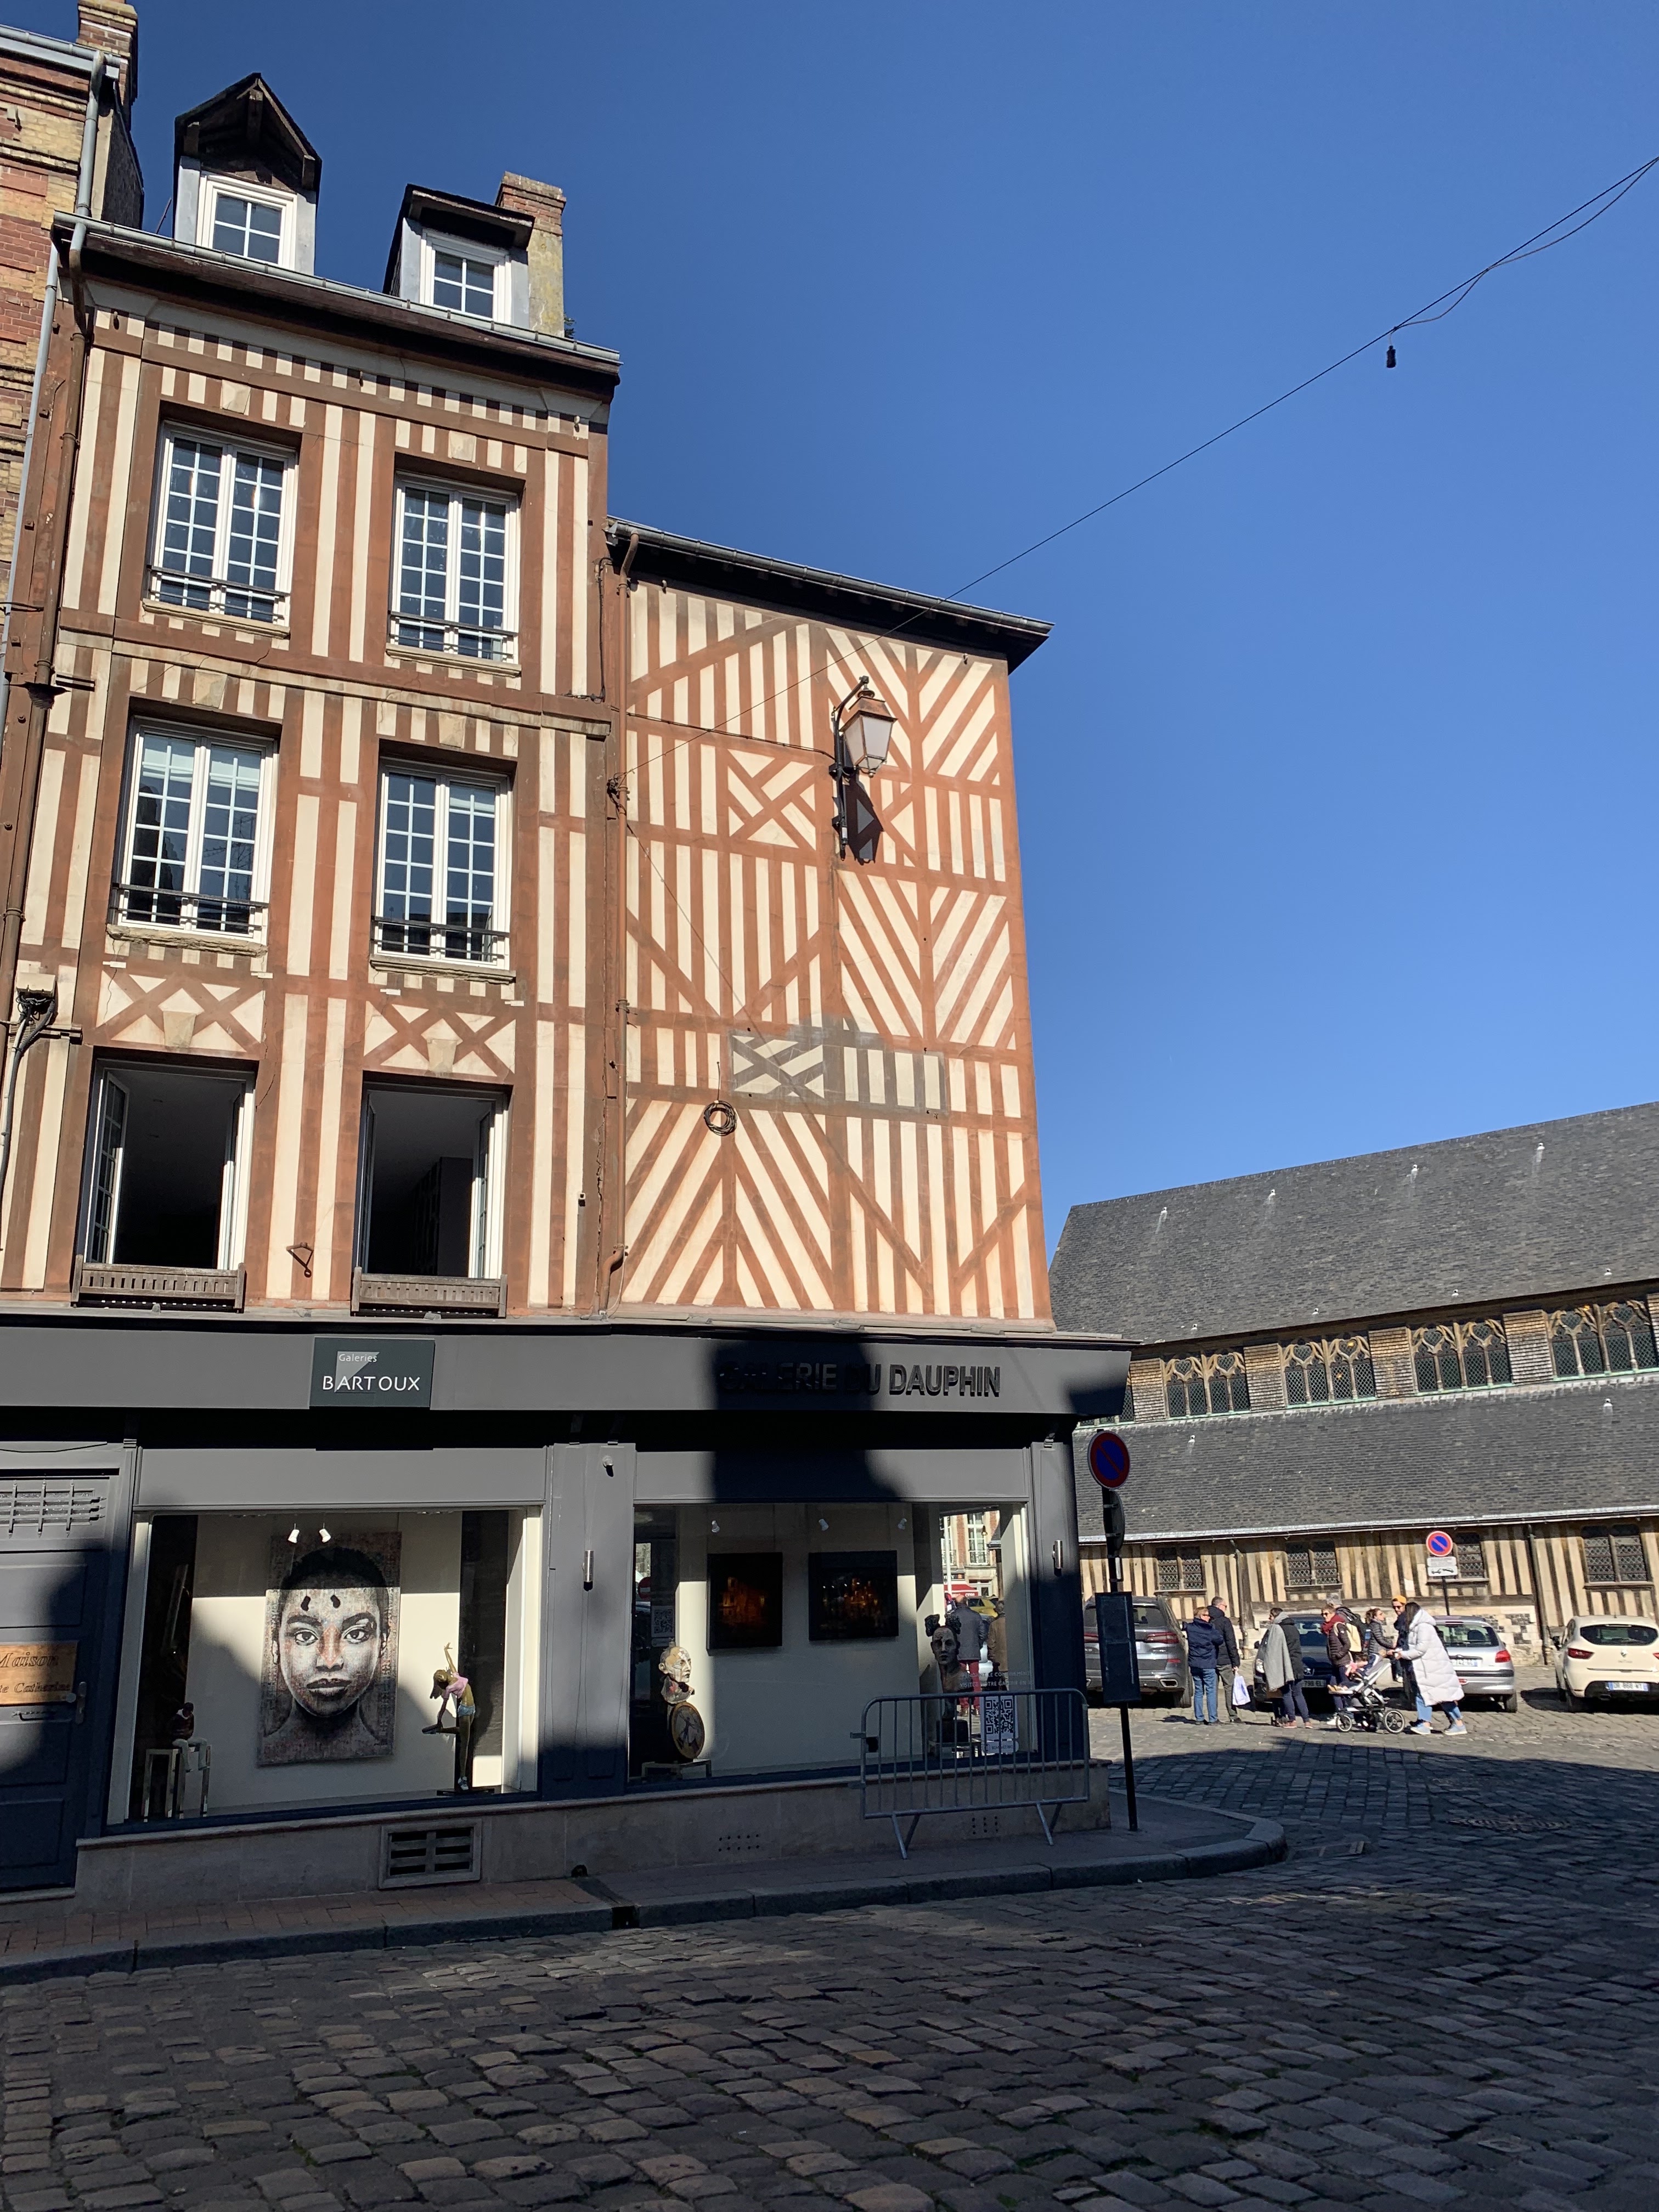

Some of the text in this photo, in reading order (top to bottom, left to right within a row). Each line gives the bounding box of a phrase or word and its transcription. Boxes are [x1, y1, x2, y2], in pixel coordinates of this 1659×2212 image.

[338, 1353, 377, 1363] Galeries
[323, 1375, 420, 1391] BARTOUX
[845, 1364, 882, 1395] DU
[889, 1364, 1001, 1397] DAUPHIN
[14, 1681, 70, 1694] Catherine
